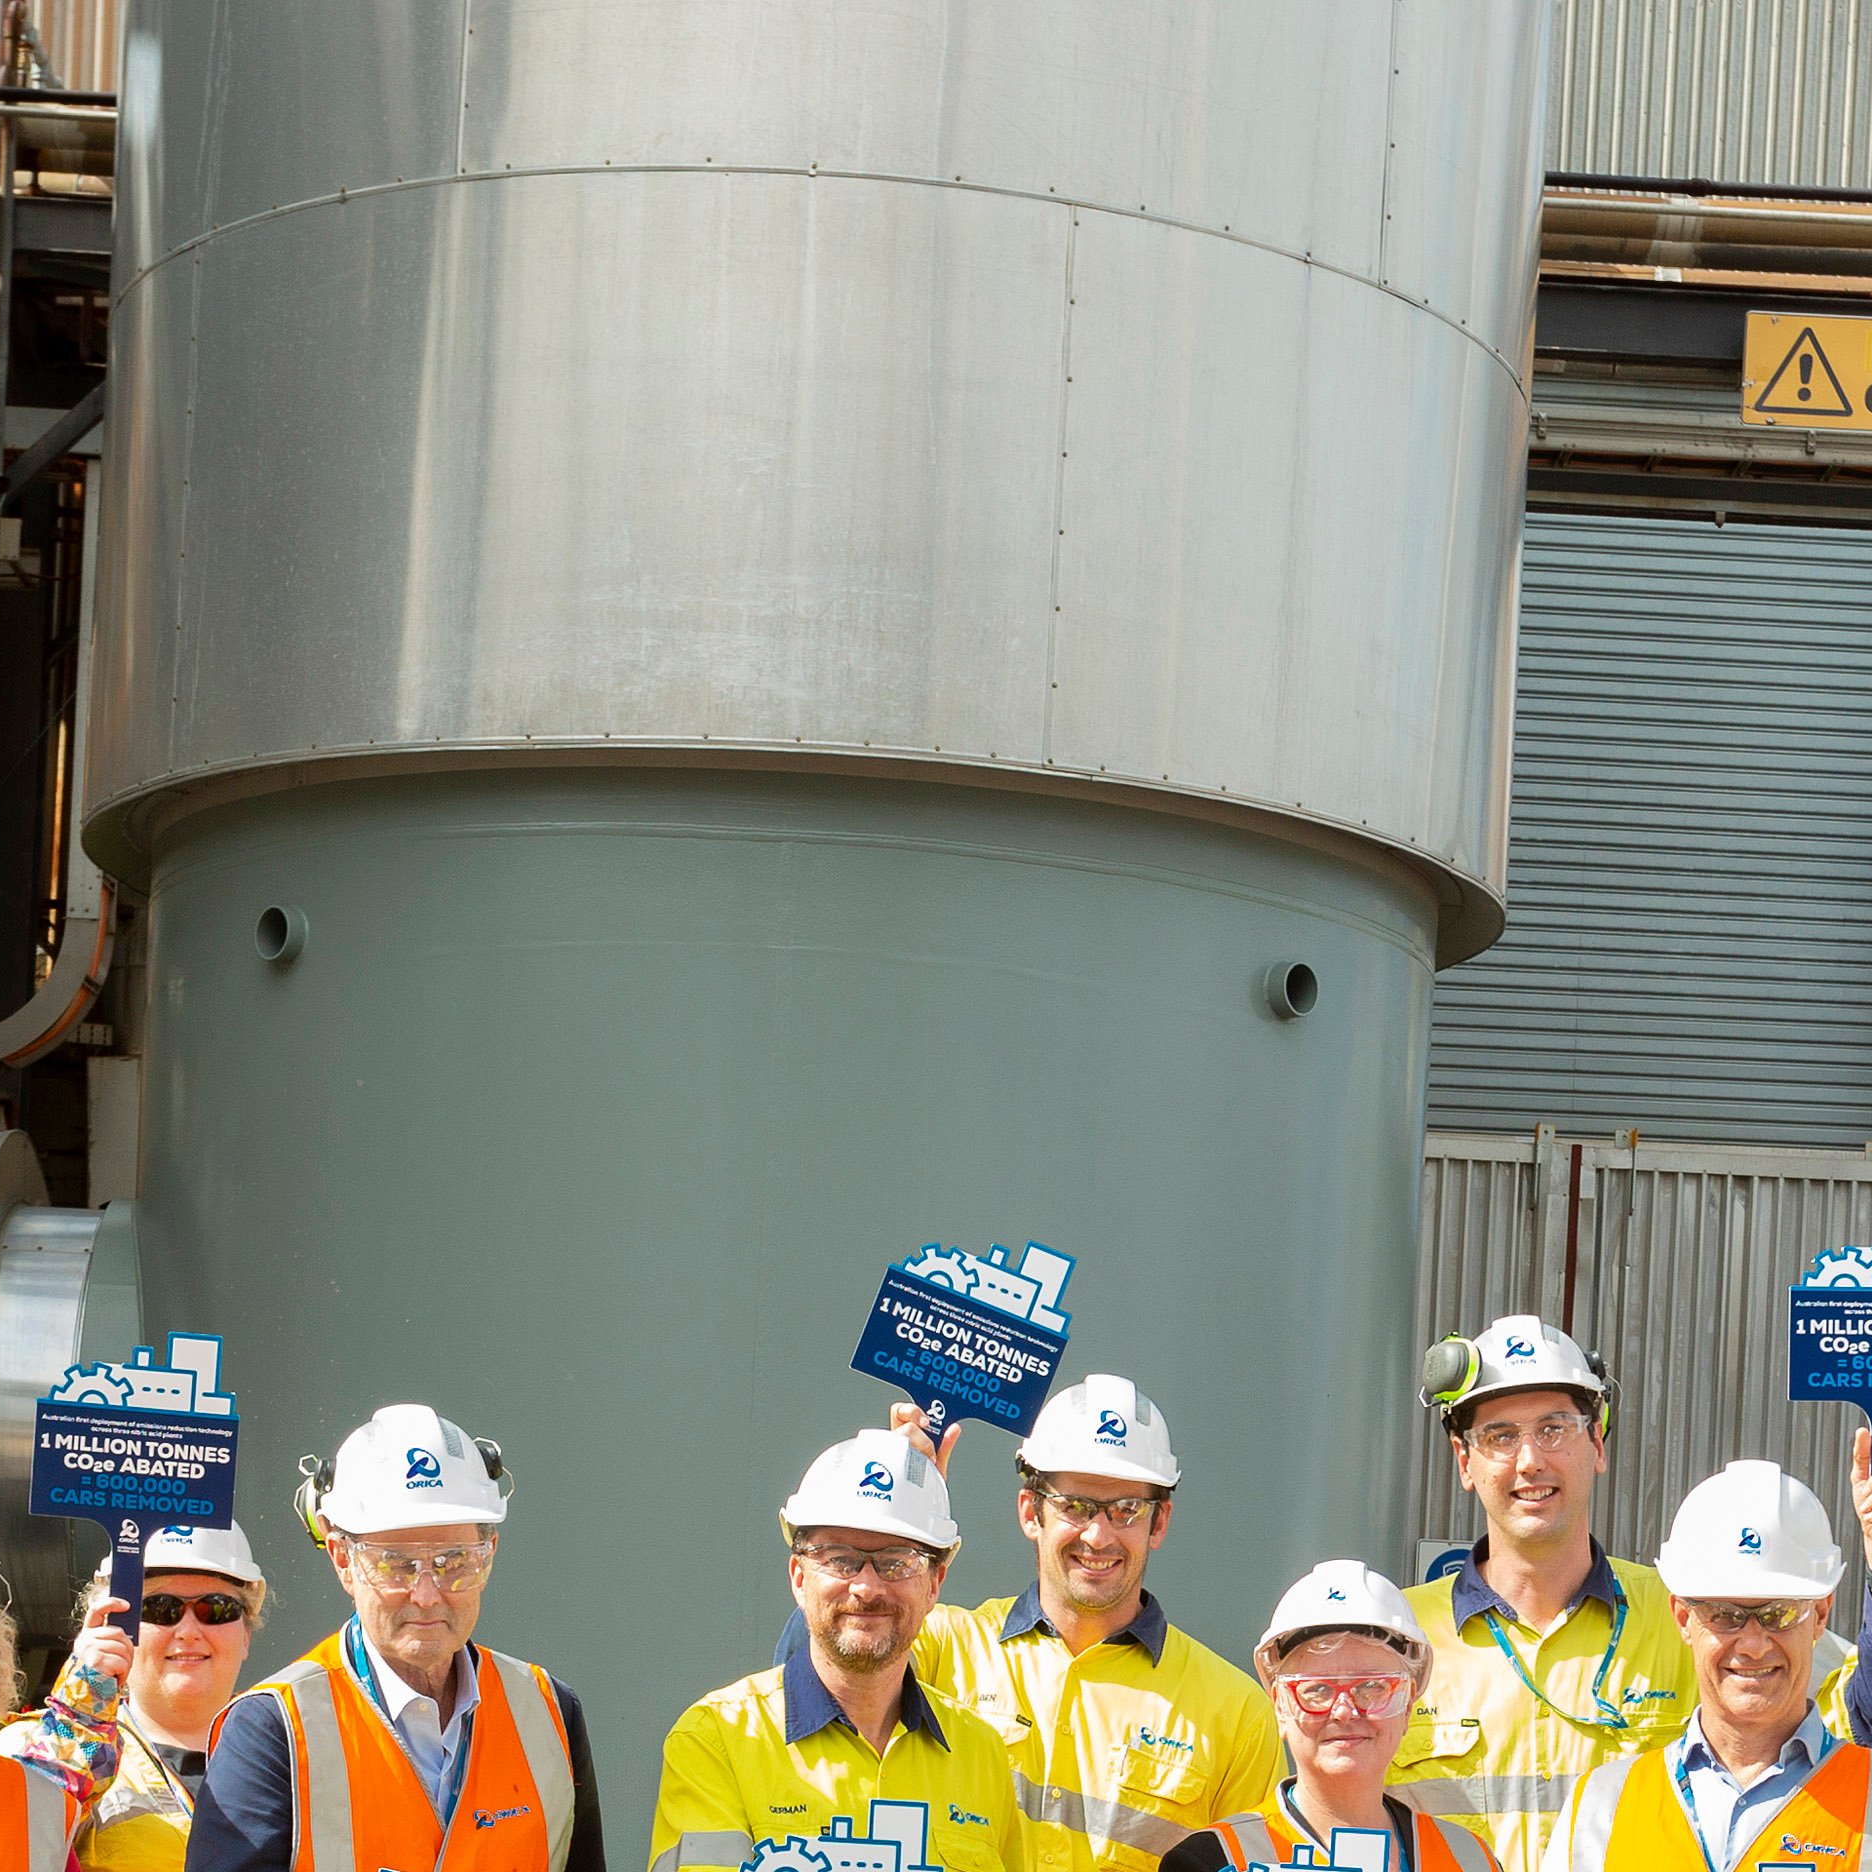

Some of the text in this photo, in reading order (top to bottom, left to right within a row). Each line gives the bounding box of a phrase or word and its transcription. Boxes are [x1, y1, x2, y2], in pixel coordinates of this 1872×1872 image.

[1796, 1318, 1806, 1335] 1
[1807, 1371, 1863, 1388] CARS
[406, 1480, 444, 1490] ORICA
[1416, 1707, 1438, 1716] DAN
[769, 1804, 807, 1815] GERMAN
